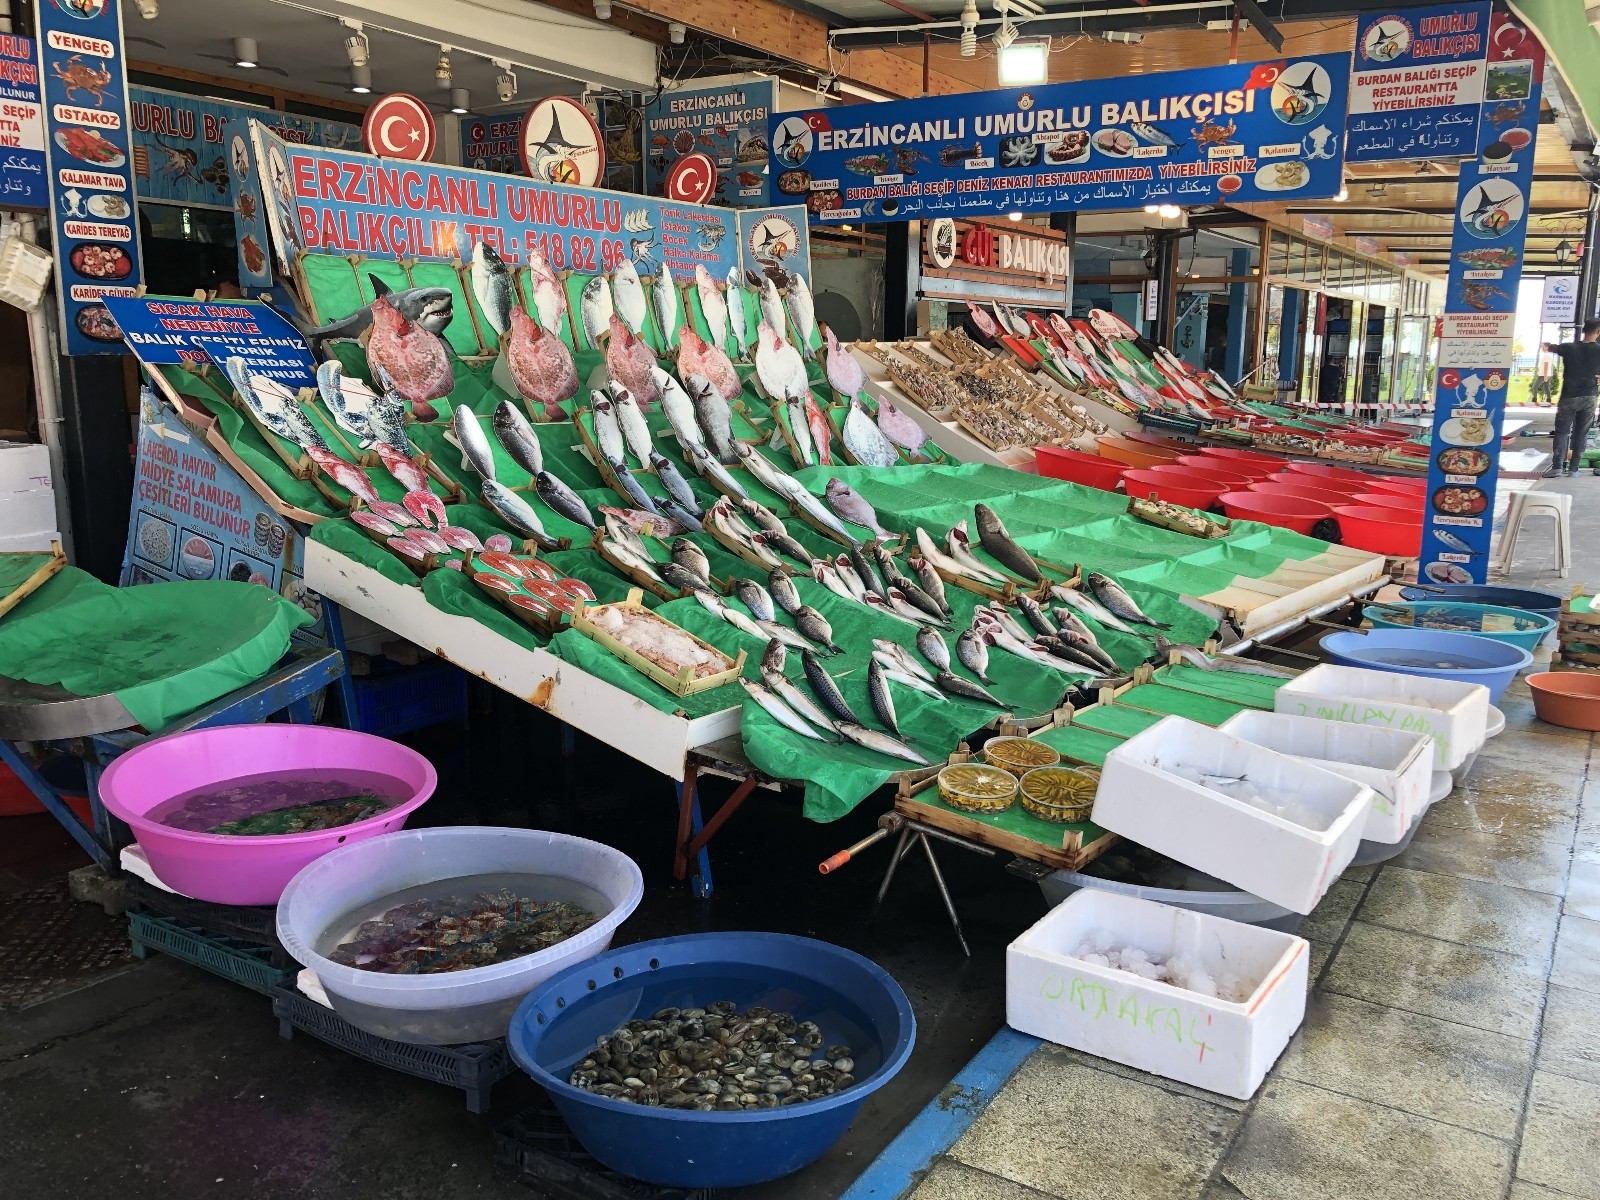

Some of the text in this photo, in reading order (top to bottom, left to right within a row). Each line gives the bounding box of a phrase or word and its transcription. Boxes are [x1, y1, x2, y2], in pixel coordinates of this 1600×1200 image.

[1420, 12, 1478, 37] UMURLU
[0, 35, 30, 59] RLU
[52, 34, 110, 56] YENGEÇ
[1412, 34, 1481, 59] BALIKÇISI
[1357, 65, 1478, 87] BURDAN BALIĞI SEÇİP
[1372, 82, 1459, 98] RESTAURANTTA
[3, 104, 36, 121] SEÇİP
[670, 92, 746, 113] ERZİNCANLI
[1372, 95, 1456, 111] YİYEBİLİRSİNİZ
[58, 107, 119, 128] ISTAKOZ
[649, 106, 768, 132] UMURLU BALIKÇISI
[818, 89, 1256, 152] ERZİNCANLI UMURLU BALIKÇISI
[1434, 111, 1474, 129] يمكنكم
[1263, 145, 1297, 156] Kalamar
[1397, 138, 1415, 152] في
[846, 156, 1257, 201] BURDAN BALIĞI SEÇİP DENİZ KENARI RESTAURANTIMIZDA YİYEBİLİRSİNİZ
[1485, 164, 1512, 173] Havyar
[61, 171, 125, 190] KALAMAR TAVA
[1176, 179, 1212, 196] يمكنك
[291, 155, 499, 220] ERZİNCANLI
[506, 185, 622, 235] UMURLU
[996, 193, 1010, 210] في
[66, 221, 131, 239] KARİDES TEREYAĞ
[299, 206, 626, 273] BALIKÇILIK TEL: 518 82 96
[999, 234, 1070, 285] BALIKÇISI
[73, 285, 107, 299] KARİDES
[146, 301, 256, 320] SICAK HAVA
[160, 318, 262, 335] NEDENİYLE
[129, 332, 189, 347] BALIK
[225, 344, 278, 357] TORİK
[142, 438, 217, 482] LAKERDA HAVYAR
[139, 458, 176, 488] MİDYE
[176, 473, 243, 514] SALAMURA
[137, 479, 192, 515] ÇEŞİTLERİ
[192, 500, 252, 540] BULUNUR
